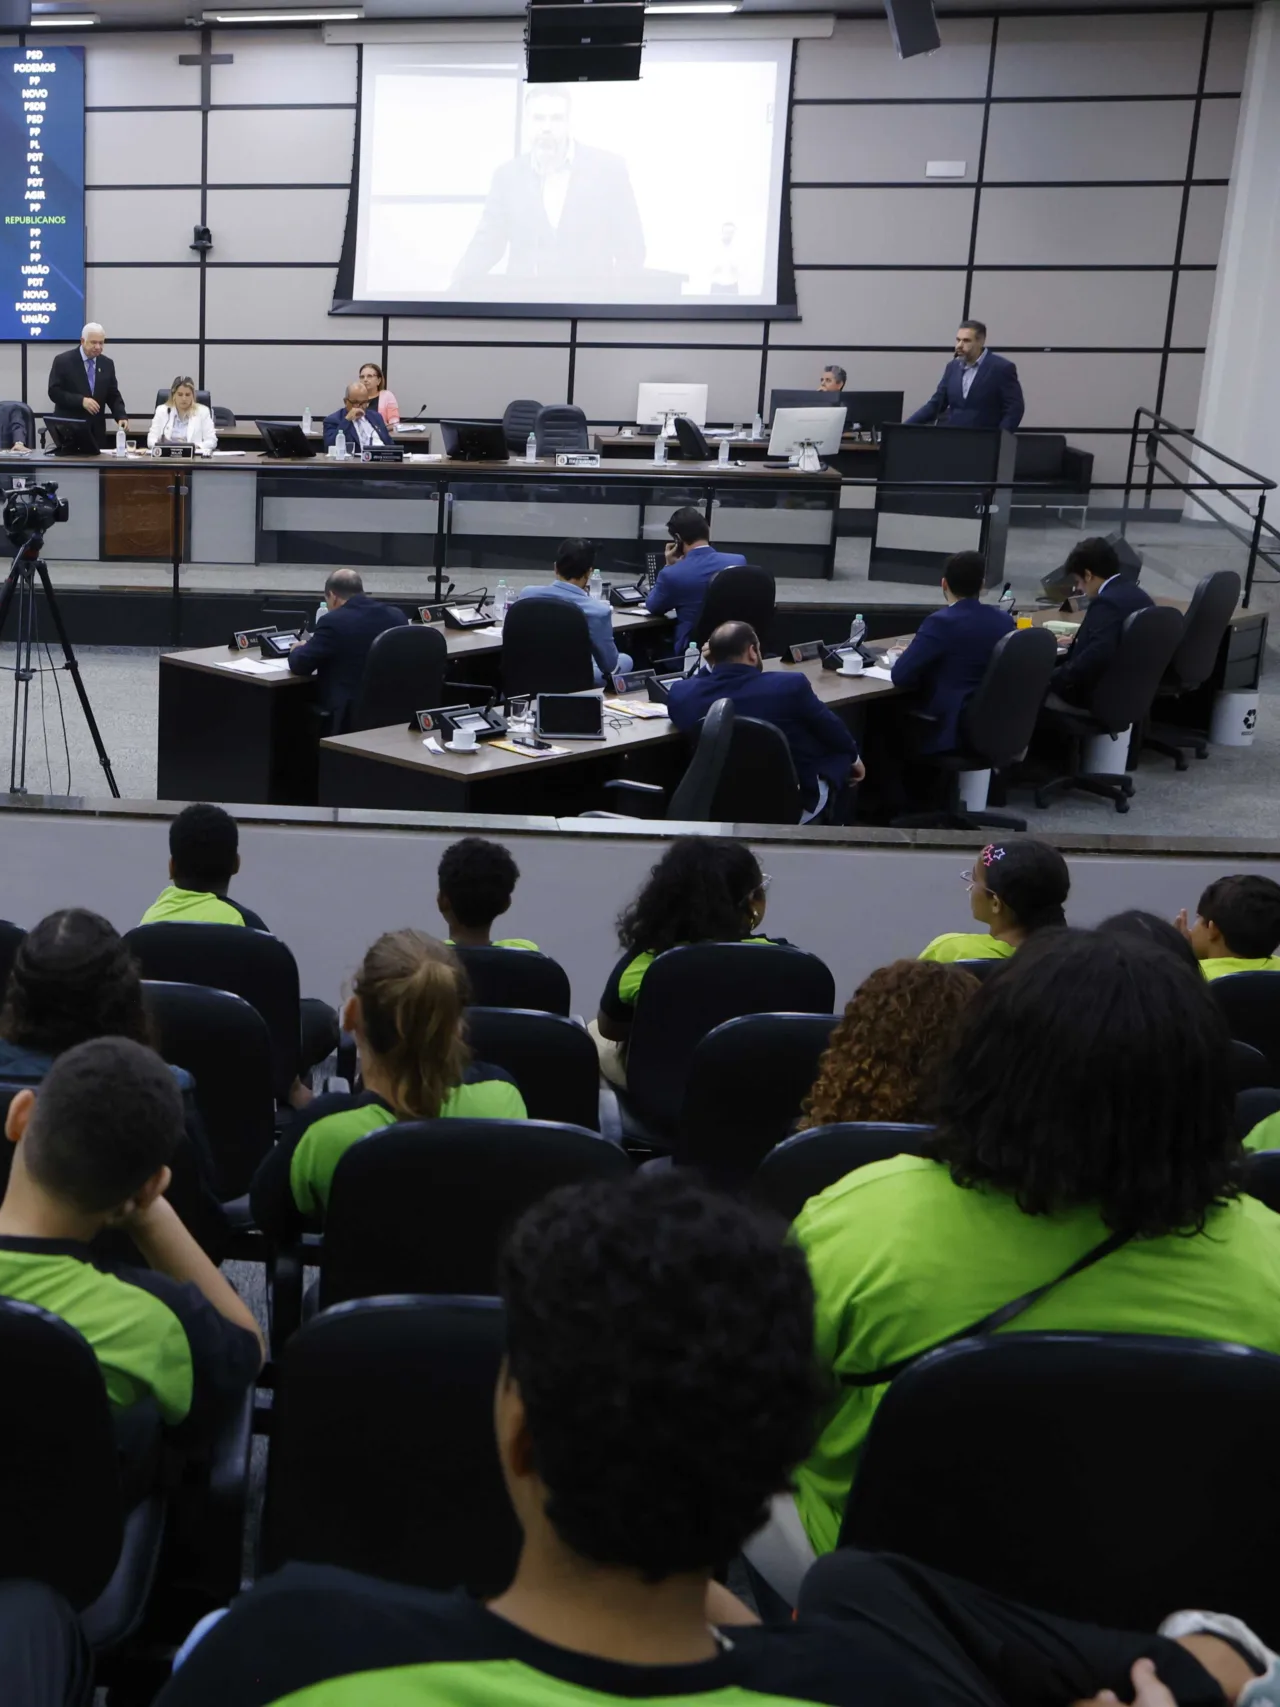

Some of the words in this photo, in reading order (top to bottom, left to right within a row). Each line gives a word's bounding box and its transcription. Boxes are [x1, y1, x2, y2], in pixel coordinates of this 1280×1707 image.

[26, 51, 43, 60] PSD
[14, 63, 56, 73] PODEMOS
[29, 77, 40, 85] PP
[22, 89, 48, 98] NOVO
[26, 115, 43, 124] PSD
[29, 128, 40, 136] PP
[30, 141, 40, 149] PL
[27, 153, 43, 162] PDT
[30, 166, 40, 174] PL
[27, 178, 43, 187] PDT
[25, 191, 45, 200] AGIR
[30, 204, 40, 212] PP
[5, 216, 66, 224] REPUBLICANOS
[30, 228, 40, 237] PP
[30, 241, 40, 249] PT
[30, 254, 40, 262] PP
[21, 264, 49, 274] UNIÃO
[28, 278, 44, 287] PDT
[23, 290, 48, 299] NOVO
[15, 303, 56, 312] PODEMOS
[22, 313, 50, 324] UNIÃO
[30, 328, 41, 336] PP
